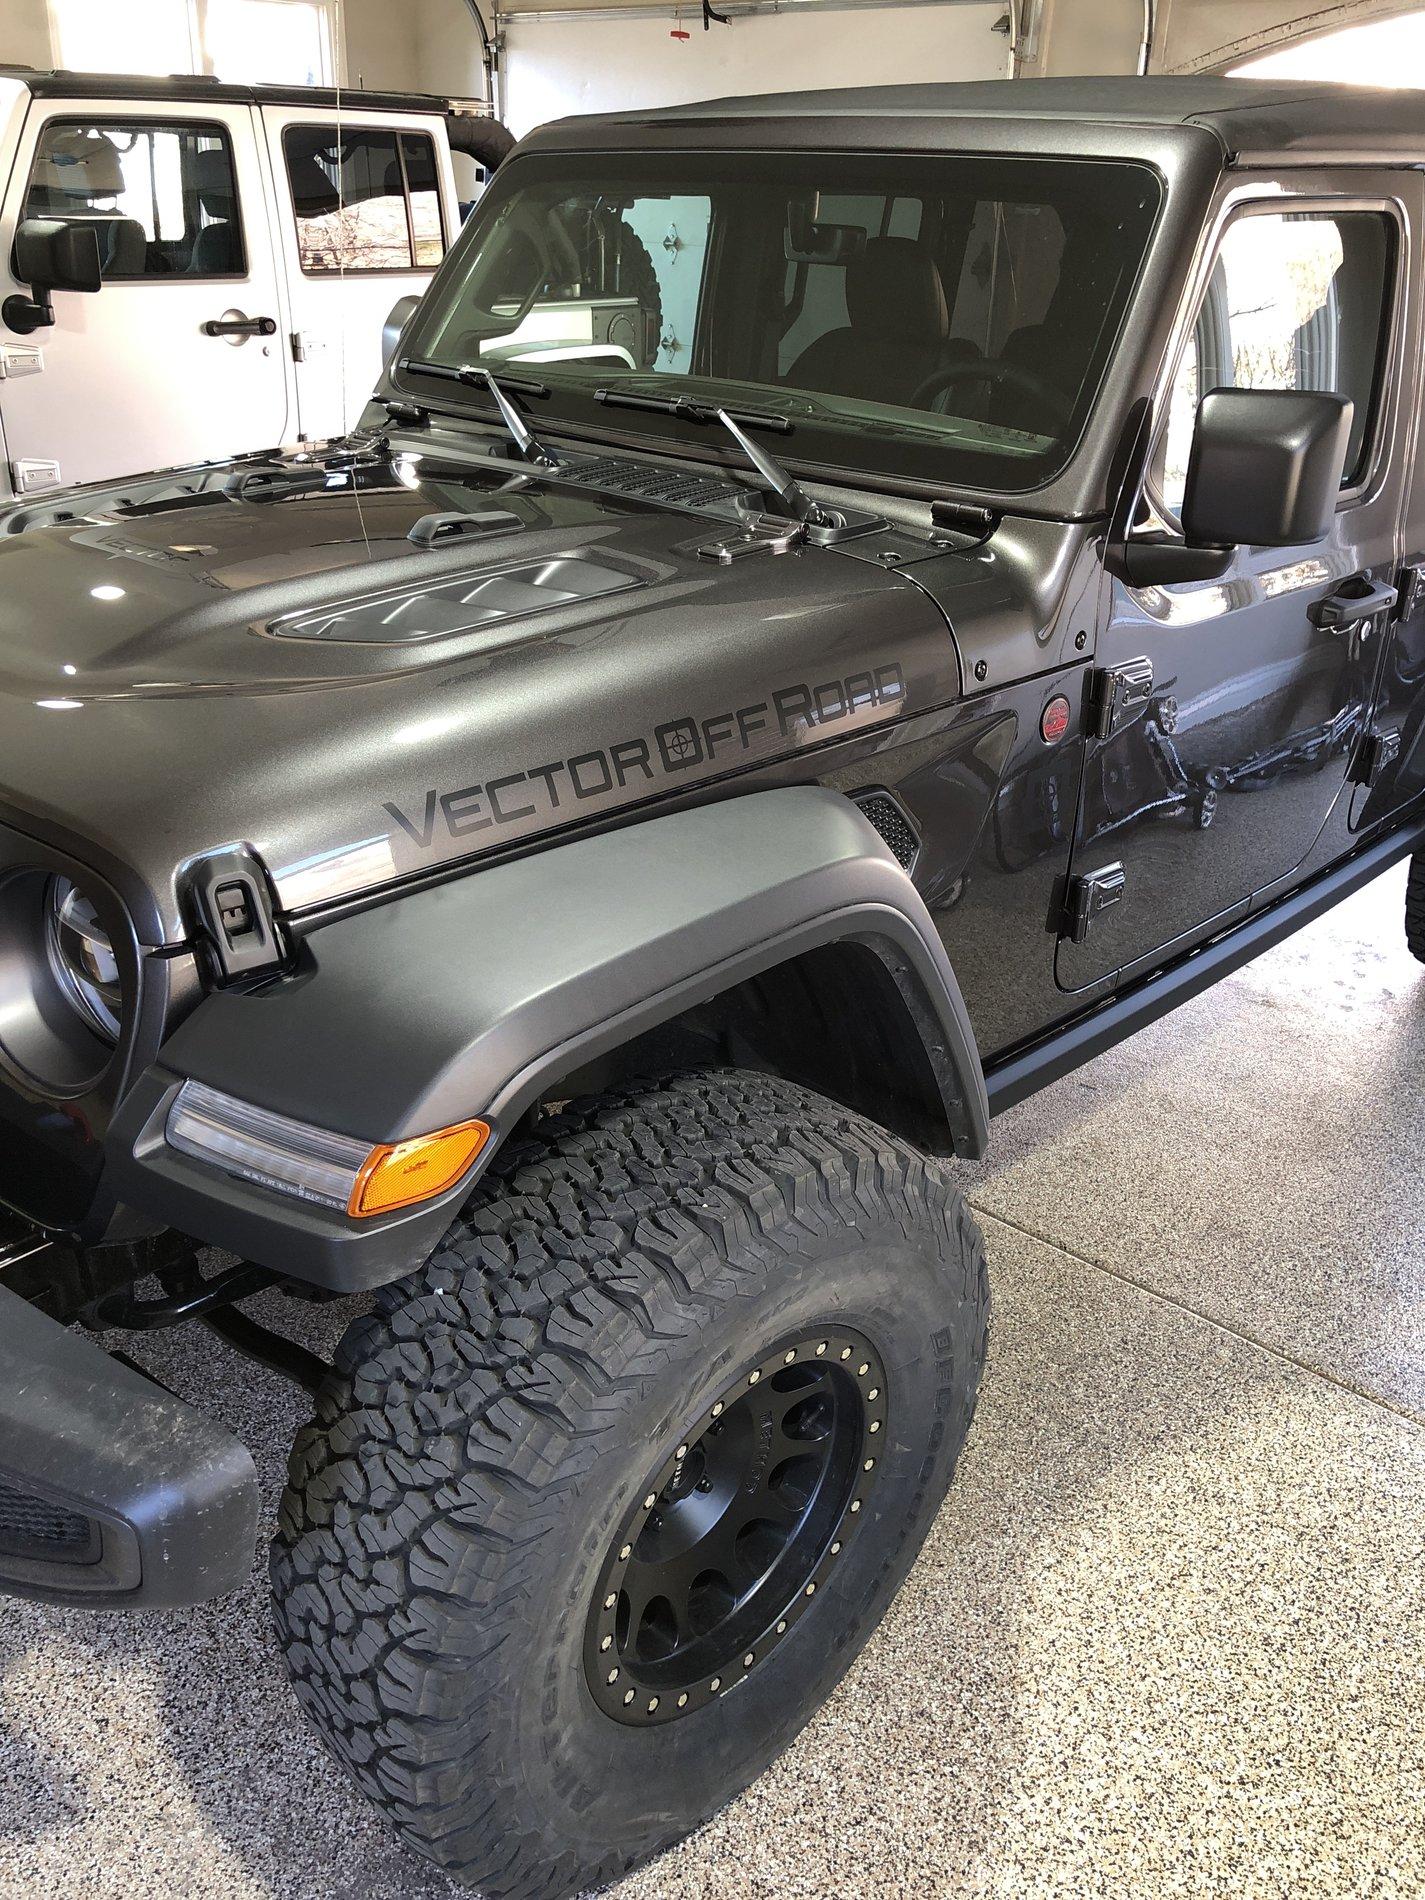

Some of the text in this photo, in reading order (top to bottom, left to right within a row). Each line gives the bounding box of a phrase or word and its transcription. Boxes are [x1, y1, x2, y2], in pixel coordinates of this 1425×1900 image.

[382, 661, 905, 849] VECTOR OFF ROAD
